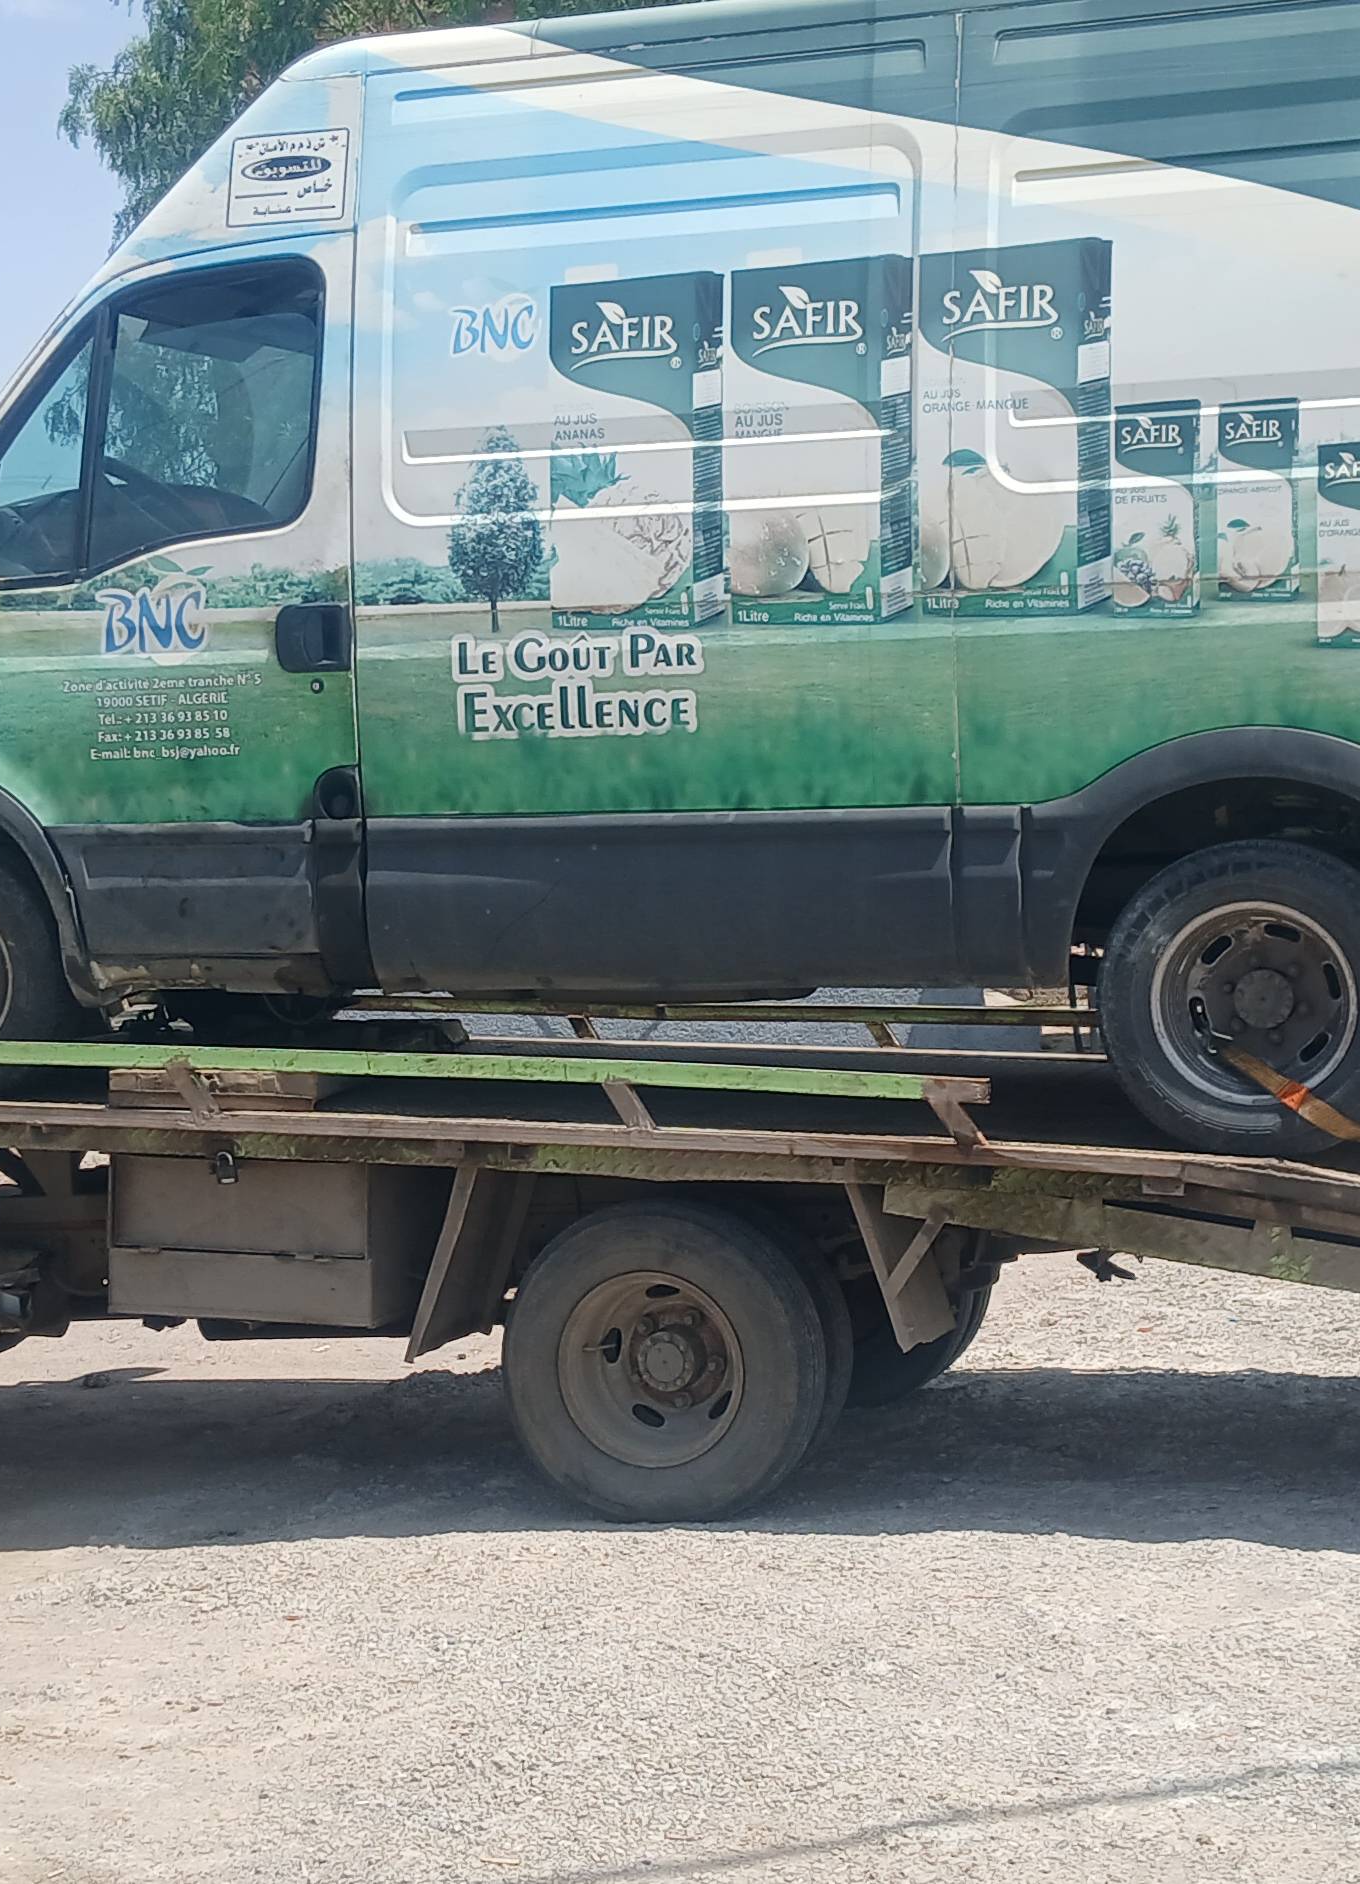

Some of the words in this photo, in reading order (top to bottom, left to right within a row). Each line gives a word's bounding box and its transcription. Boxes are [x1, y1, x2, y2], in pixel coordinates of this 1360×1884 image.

[943, 284, 1060, 324] SAFIR
[451, 303, 536, 355] BNC
[752, 299, 864, 341] SAFIR
[570, 314, 679, 354] SAFIR
[554, 415, 571, 426] AU
[573, 412, 598, 425] JUS
[735, 416, 754, 428] AU
[757, 413, 784, 427] JUS
[554, 427, 606, 442] ANANAS
[1120, 424, 1182, 445] SAFIR
[1225, 419, 1282, 441] SAFIR
[1115, 495, 1129, 504] DE
[1131, 494, 1168, 504] FRUITS
[101, 589, 207, 654] BNC
[63, 681, 93, 693] Zone
[188, 674, 235, 688] tranche
[96, 696, 134, 708] 19000
[135, 693, 168, 707] SETIF
[178, 691, 229, 705] ALGERIE
[135, 712, 158, 725] 213
[160, 711, 176, 724] 36
[177, 710, 192, 723] 93
[194, 710, 210, 722] 85
[212, 709, 228, 722] 10
[97, 731, 122, 743] Fax:
[134, 729, 157, 742] 213
[159, 729, 175, 741] 36
[176, 728, 192, 741] 93
[194, 728, 210, 740] 85
[215, 727, 231, 739] 58
